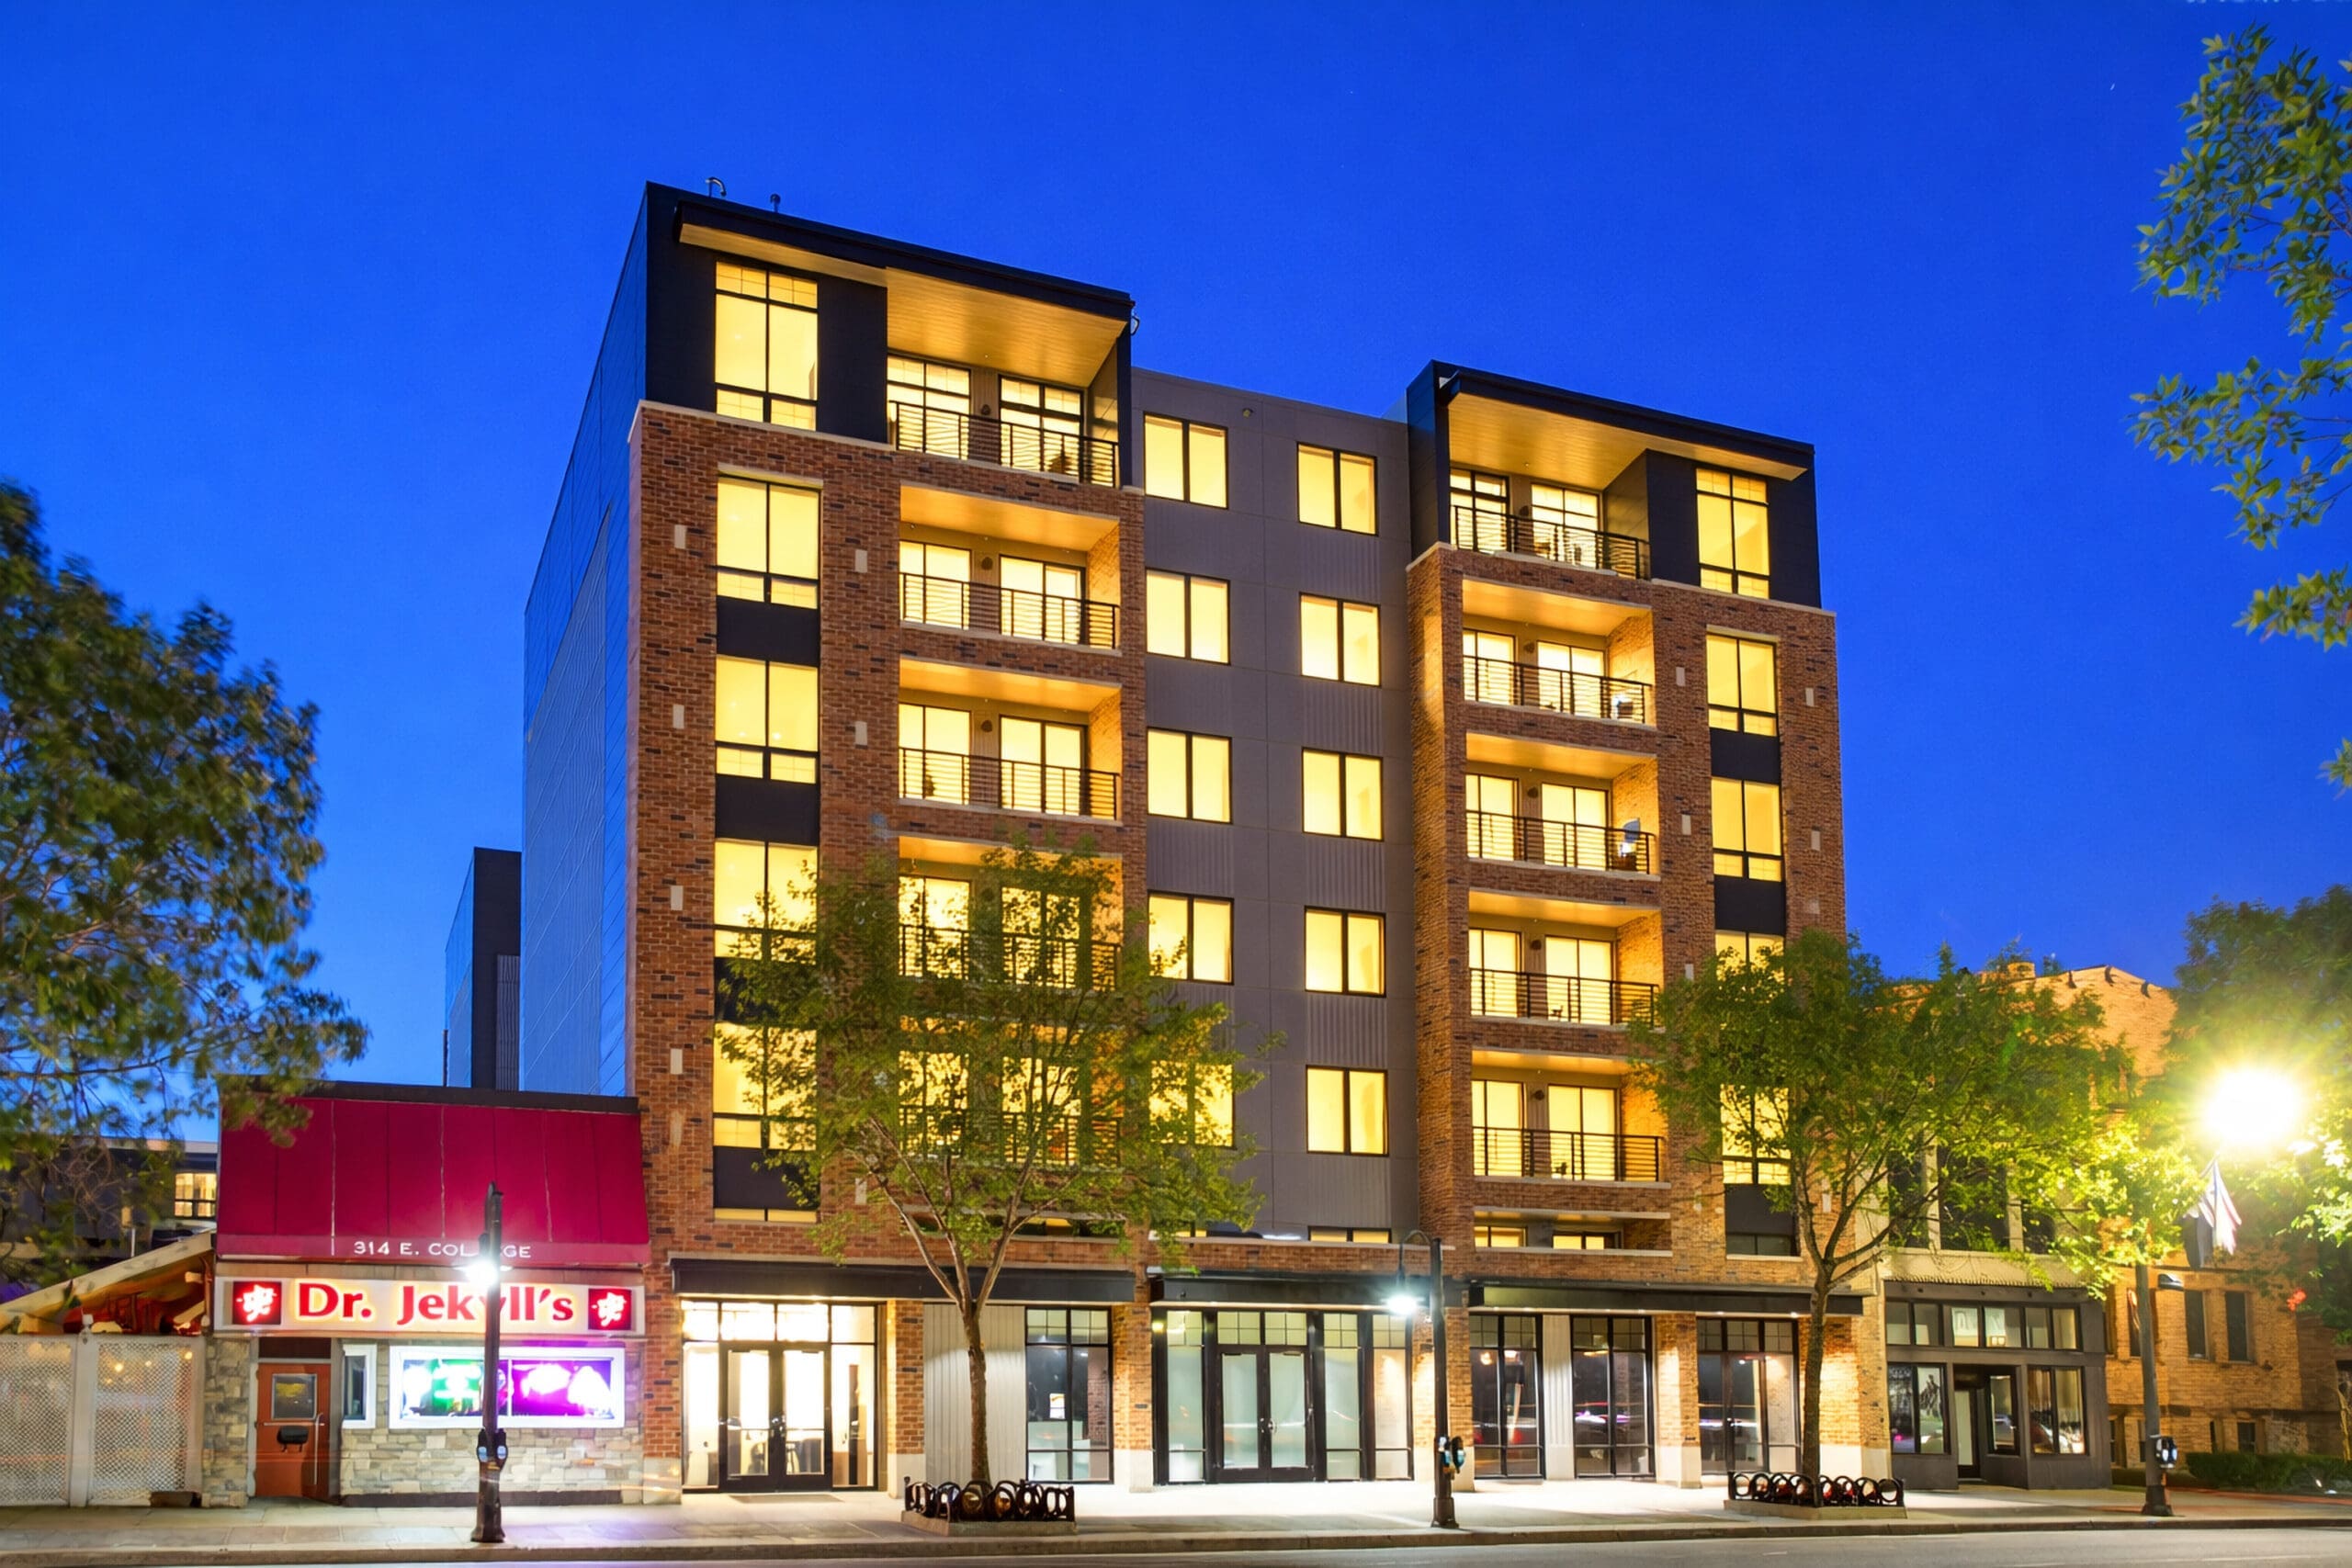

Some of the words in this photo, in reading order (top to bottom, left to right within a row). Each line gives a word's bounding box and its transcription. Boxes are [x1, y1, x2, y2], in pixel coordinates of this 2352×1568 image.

[354, 1241, 390, 1255] 314
[400, 1242, 419, 1256] E.
[428, 1243, 531, 1258] COLGE
[300, 1283, 371, 1317] Dr.
